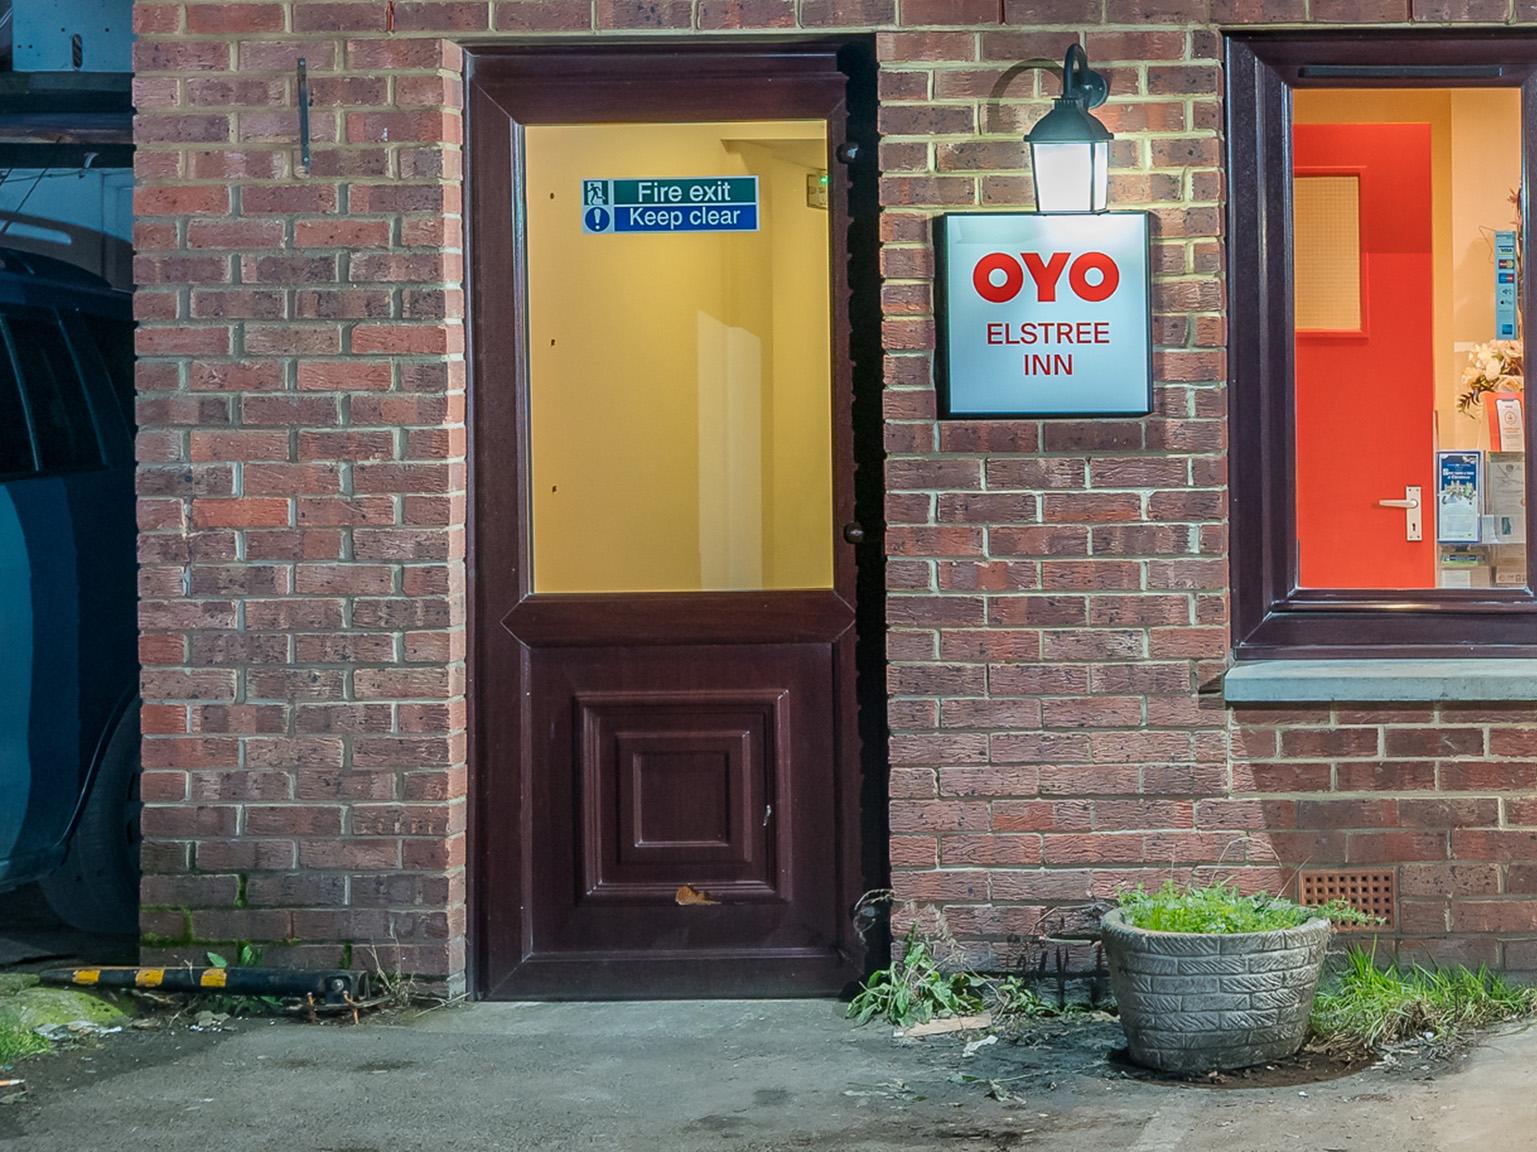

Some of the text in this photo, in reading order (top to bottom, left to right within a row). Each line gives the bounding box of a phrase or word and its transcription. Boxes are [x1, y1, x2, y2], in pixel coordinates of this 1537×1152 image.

[638, 181, 732, 202] Fire exit
[629, 206, 742, 229] Keep clear
[972, 251, 1121, 304] OYO
[986, 322, 1111, 345] ELSTREE
[1024, 354, 1074, 376] INN
